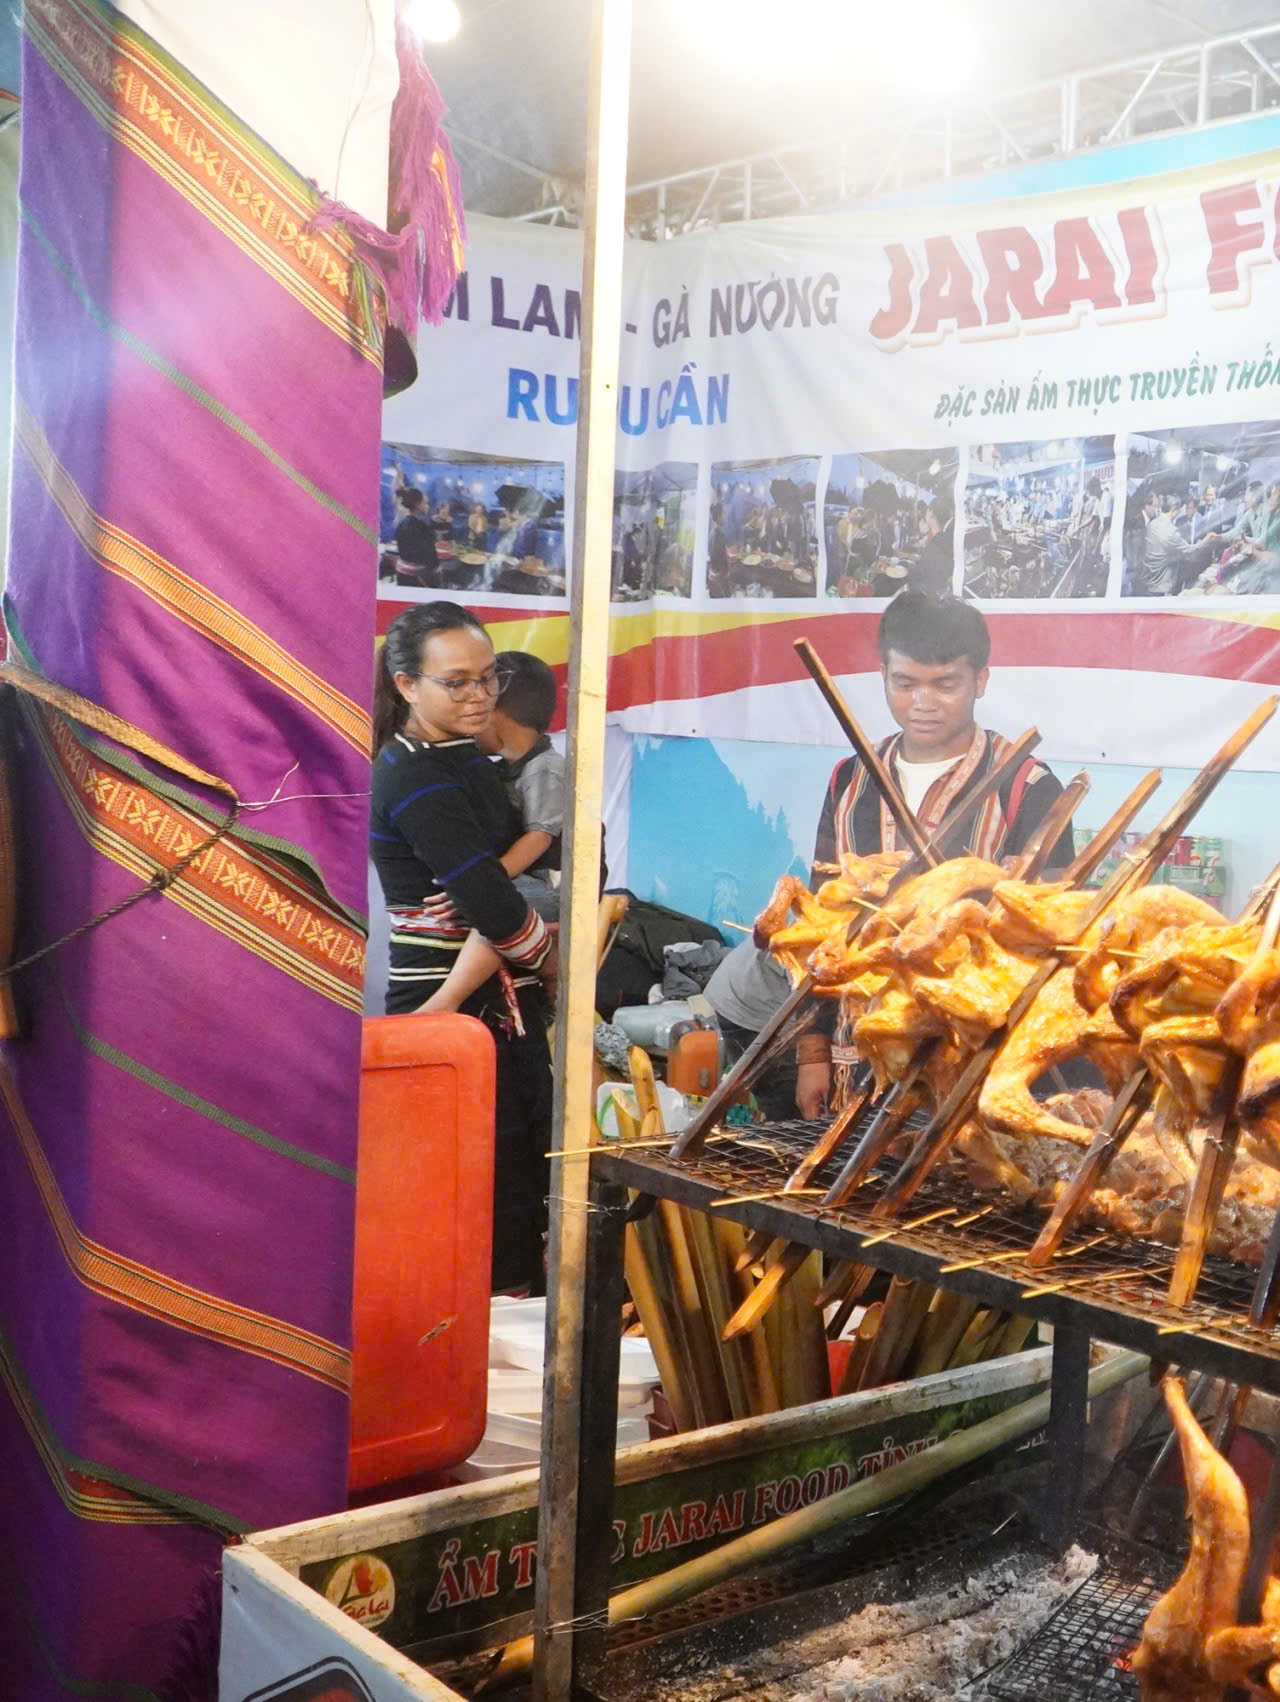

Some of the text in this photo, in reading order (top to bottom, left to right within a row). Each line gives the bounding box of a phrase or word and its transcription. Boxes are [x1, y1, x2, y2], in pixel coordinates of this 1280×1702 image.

[867, 204, 1163, 347] JARAI
[652, 284, 692, 348] GÀ
[656, 361, 731, 430] CẦN
[934, 384, 977, 428] ĐẶC
[1066, 374, 1123, 416] THỰC
[1129, 350, 1219, 402] TRUYỀN
[427, 1537, 501, 1613] ẨM
[632, 1489, 747, 1558] JARAI
[751, 1462, 850, 1525] FOOD
